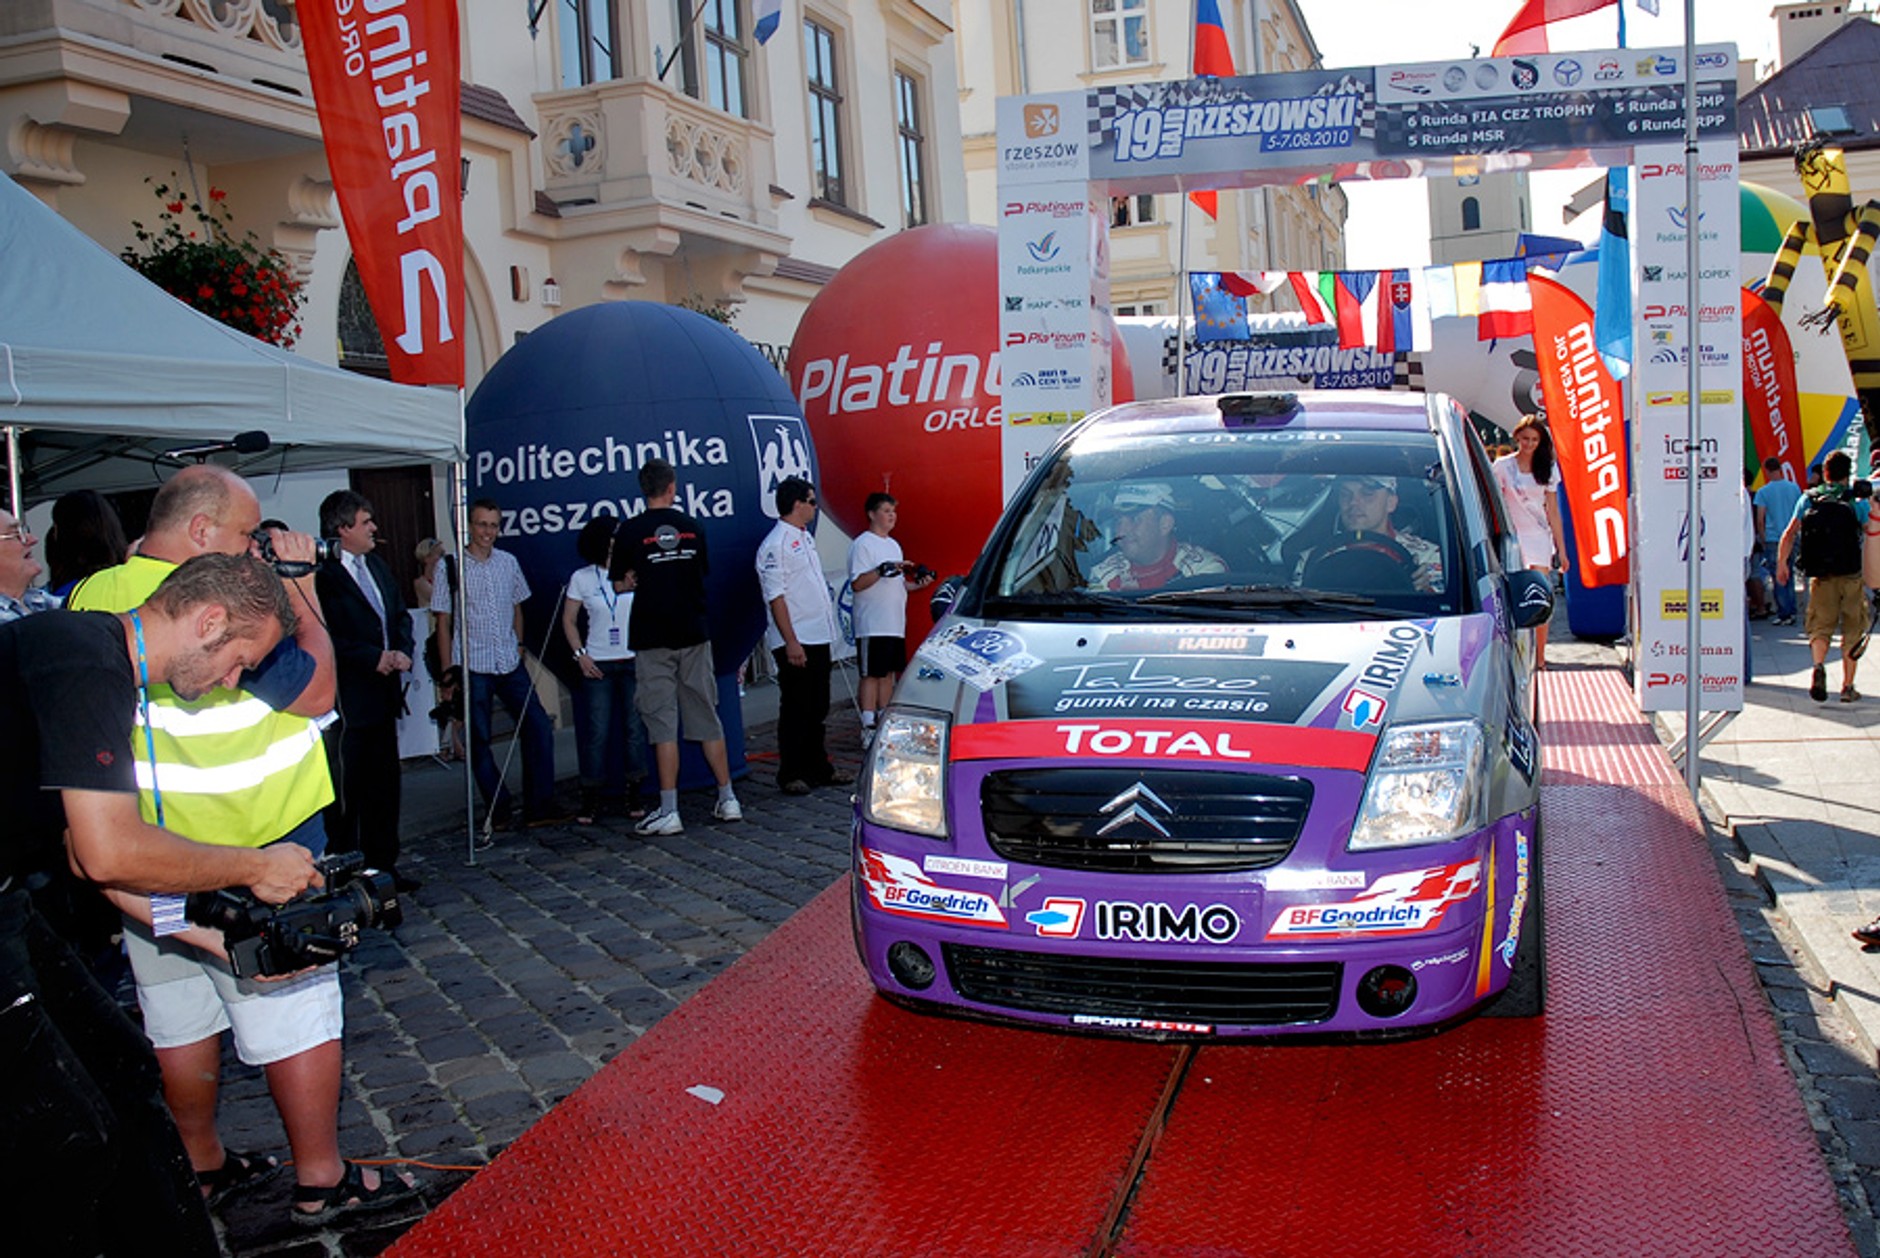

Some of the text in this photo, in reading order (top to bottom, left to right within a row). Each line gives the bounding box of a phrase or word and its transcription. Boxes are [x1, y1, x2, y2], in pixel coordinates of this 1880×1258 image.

[1186, 96, 1358, 137] RZESZOWSKI
[1407, 103, 1596, 128] 6 Runda FIA CEZ TROPHY
[1614, 101, 1625, 114] 5
[1628, 98, 1677, 113] Runda
[1114, 110, 1162, 161] 19
[1267, 129, 1350, 150] 5-7.08.2010
[1407, 129, 1505, 147] 5 Runda MSR
[1627, 119, 1638, 133] 6
[1004, 142, 1079, 161] rzeszów
[1187, 351, 1229, 395] 19
[1248, 346, 1394, 378] RZESZOWSKI
[1320, 370, 1392, 389] 5-7.08.2010
[476, 430, 729, 488] Politechnika
[1359, 626, 1422, 689] IRIMO
[1053, 657, 1259, 690] Taboo
[1054, 694, 1270, 713] gumki na czasie
[1056, 724, 1252, 759] TOTAL
[885, 886, 989, 913] BFGoodrich
[1098, 902, 1239, 942] IRIMO
[1289, 905, 1421, 926] BFGoodrich
